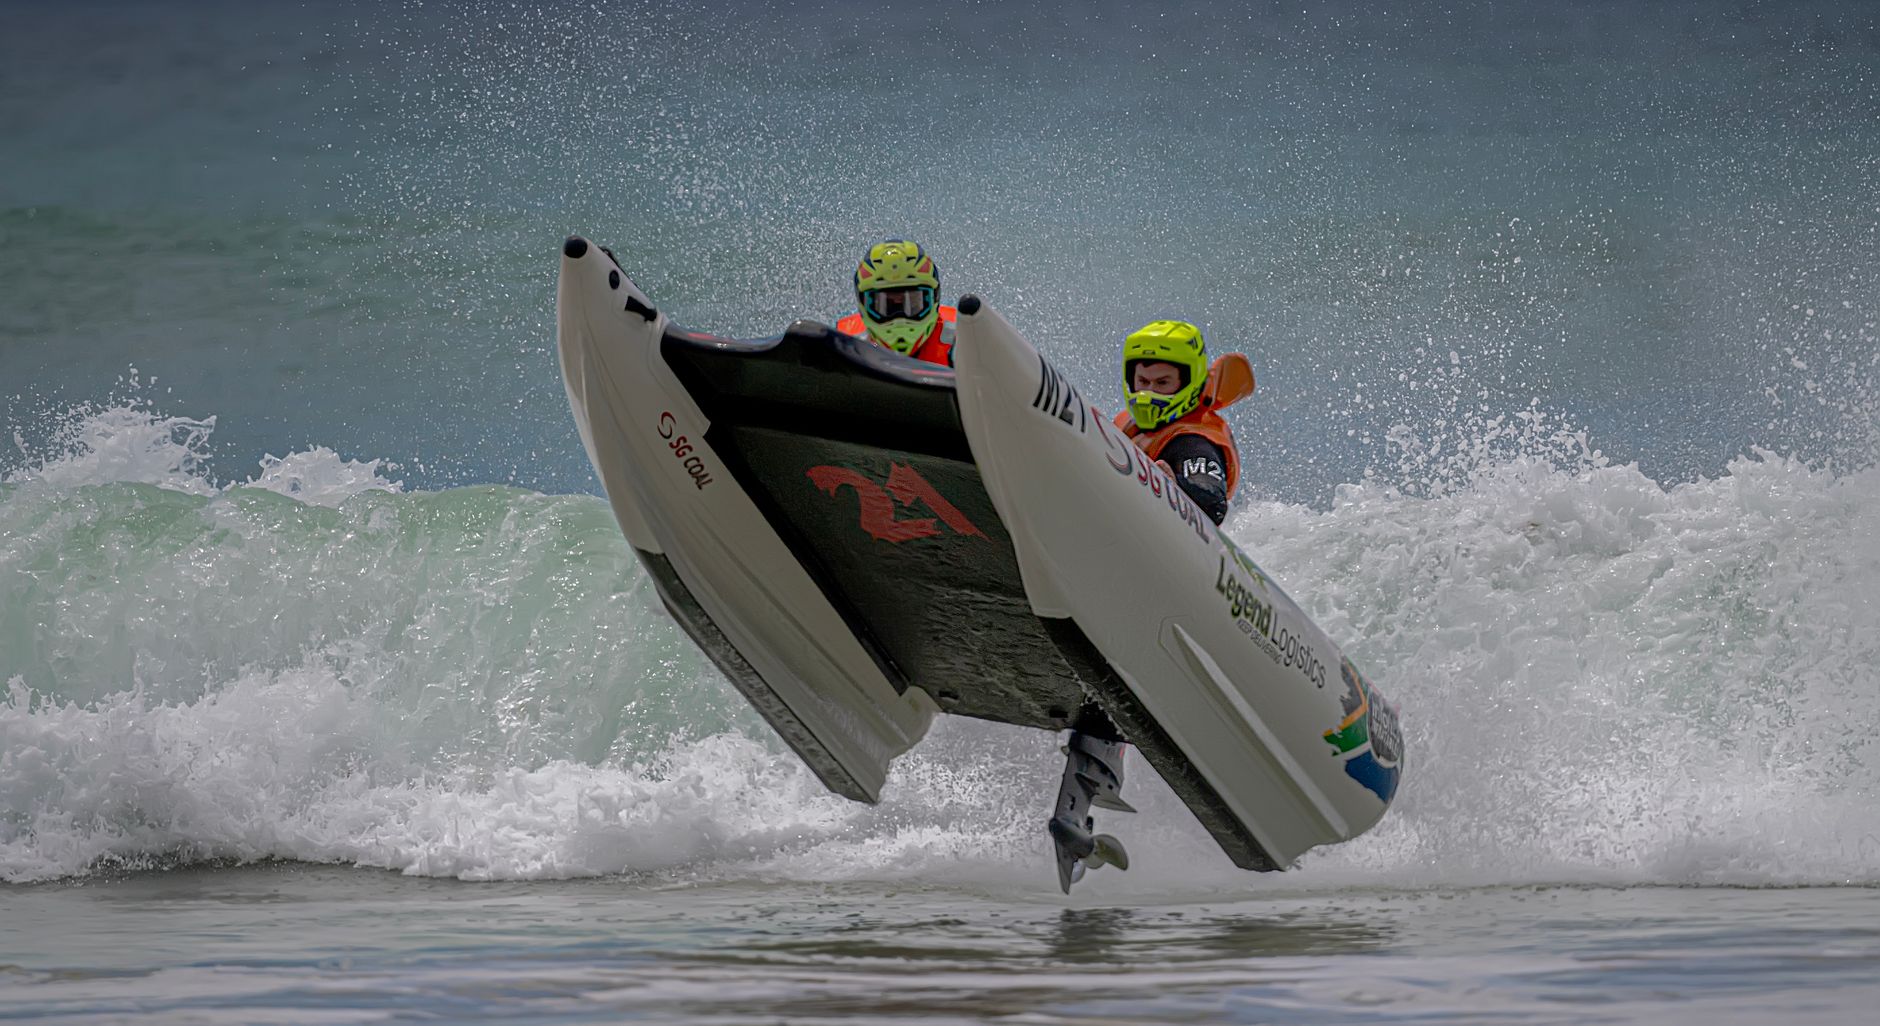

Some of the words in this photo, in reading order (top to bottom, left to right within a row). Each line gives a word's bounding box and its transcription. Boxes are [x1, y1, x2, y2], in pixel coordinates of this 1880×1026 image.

[1033, 354, 1086, 434] M21
[668, 435, 693, 458] SG
[683, 456, 713, 490] COAL
[805, 460, 996, 544] 21
[1215, 555, 1272, 638] Legend
[1271, 611, 1326, 689] Logistics
